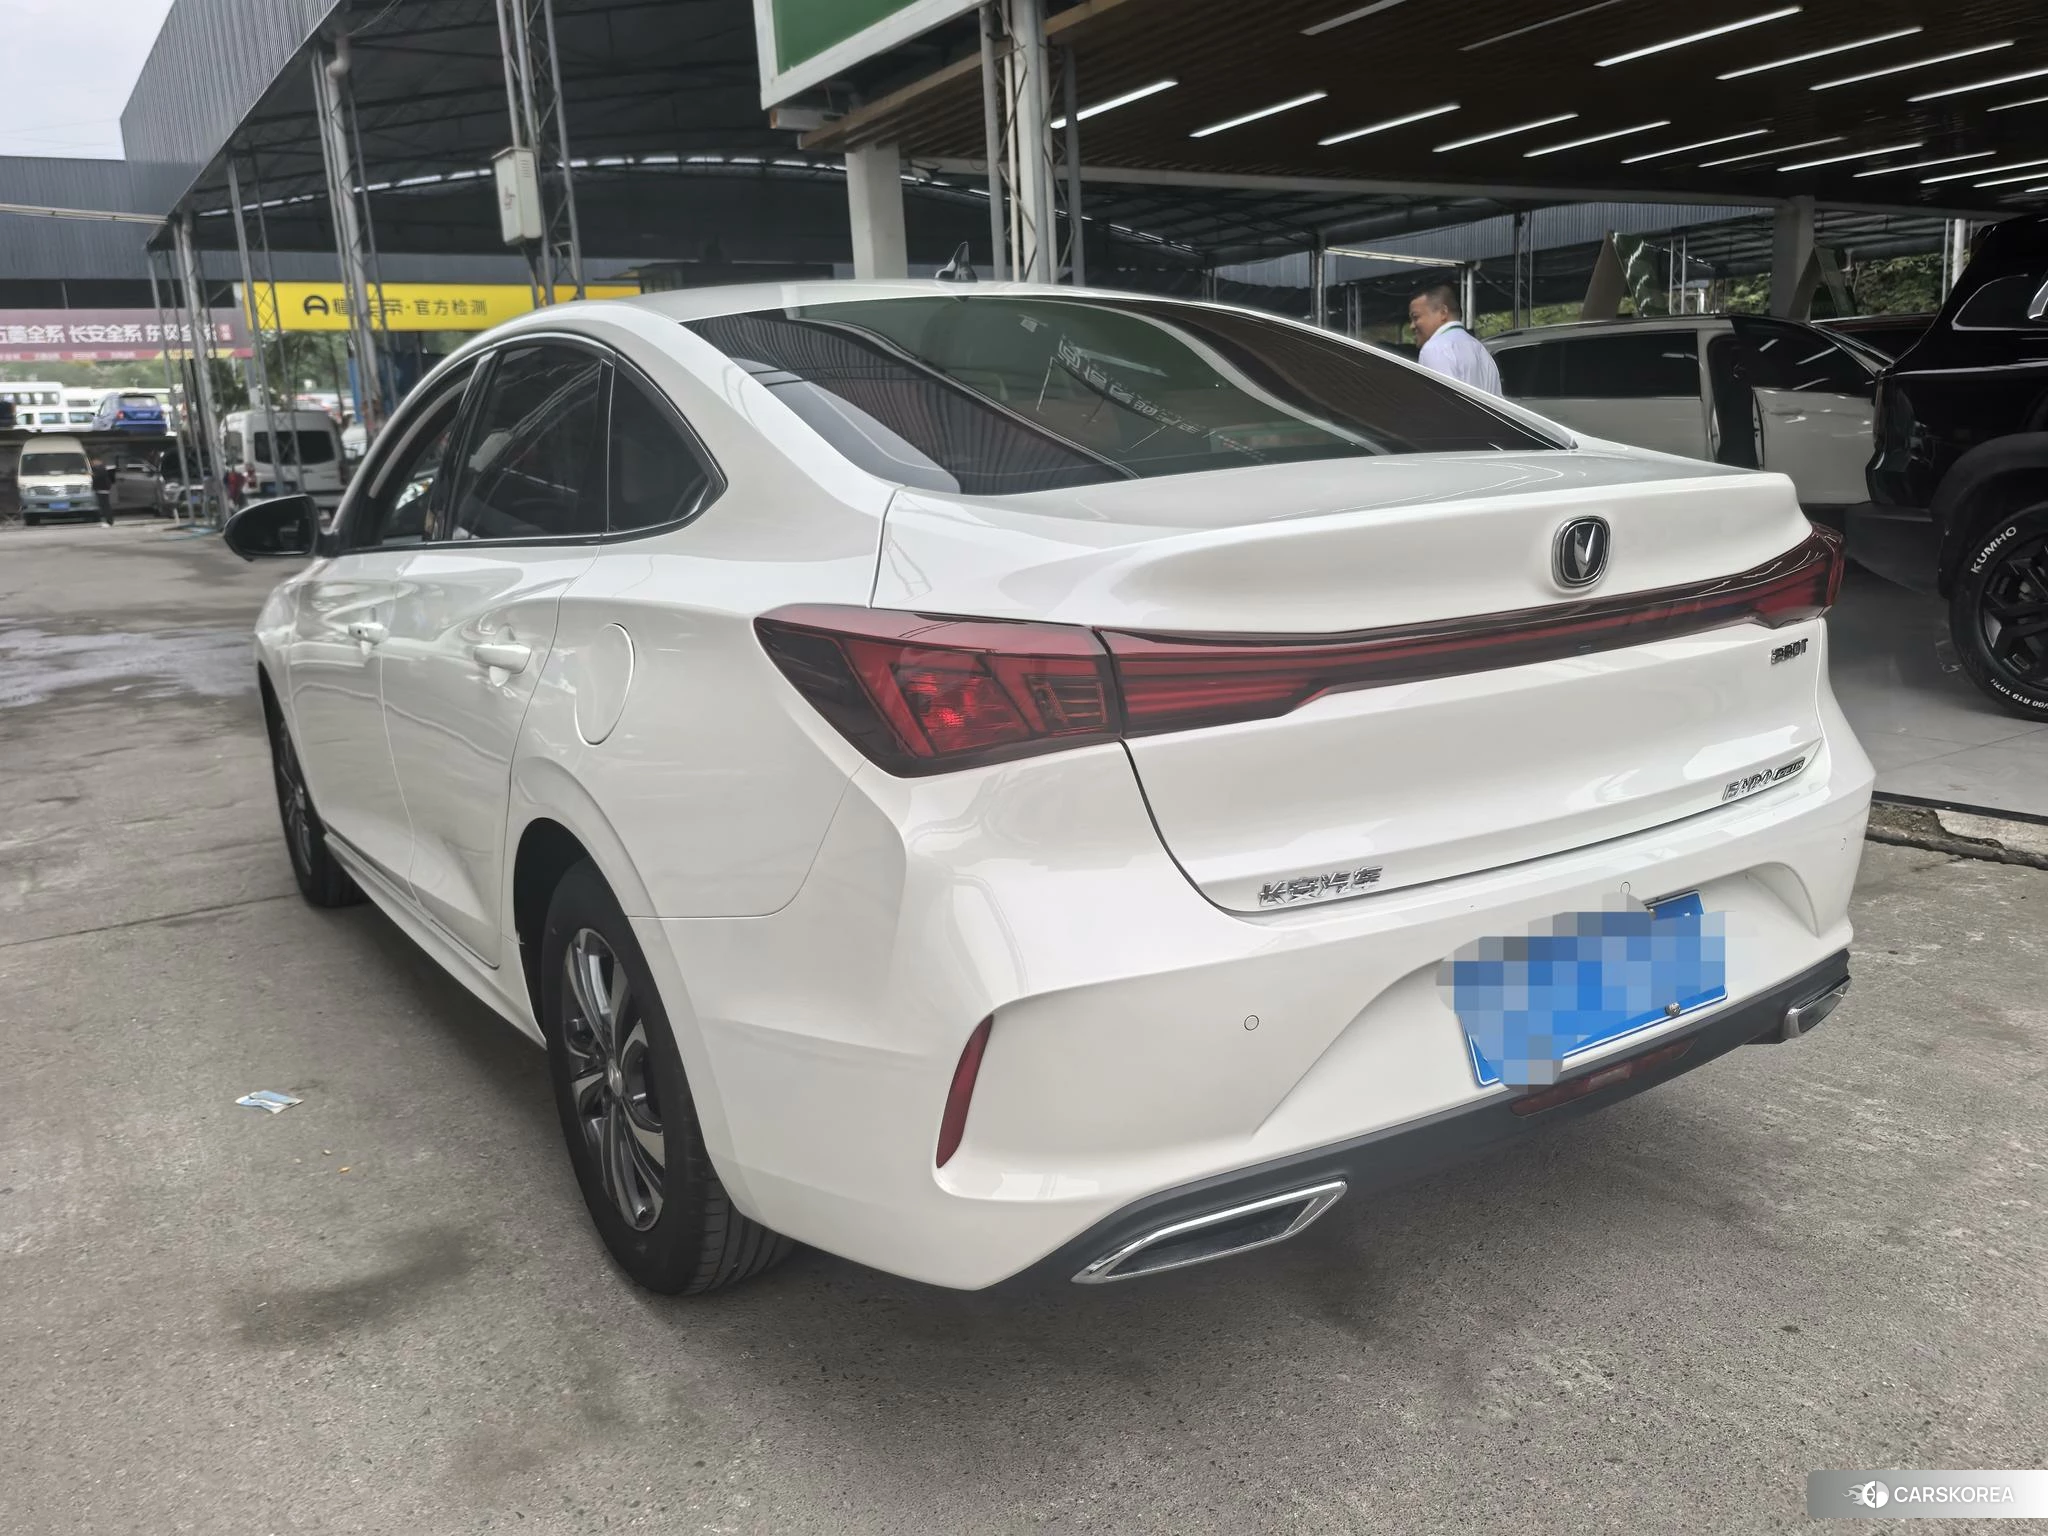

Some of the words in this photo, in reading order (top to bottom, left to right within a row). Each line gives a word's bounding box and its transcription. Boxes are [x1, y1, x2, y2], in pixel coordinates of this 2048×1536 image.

[68, 324, 143, 344] 长安全系
[1970, 526, 2017, 574] KUMHO
[1258, 866, 1383, 906] 长安汽车
